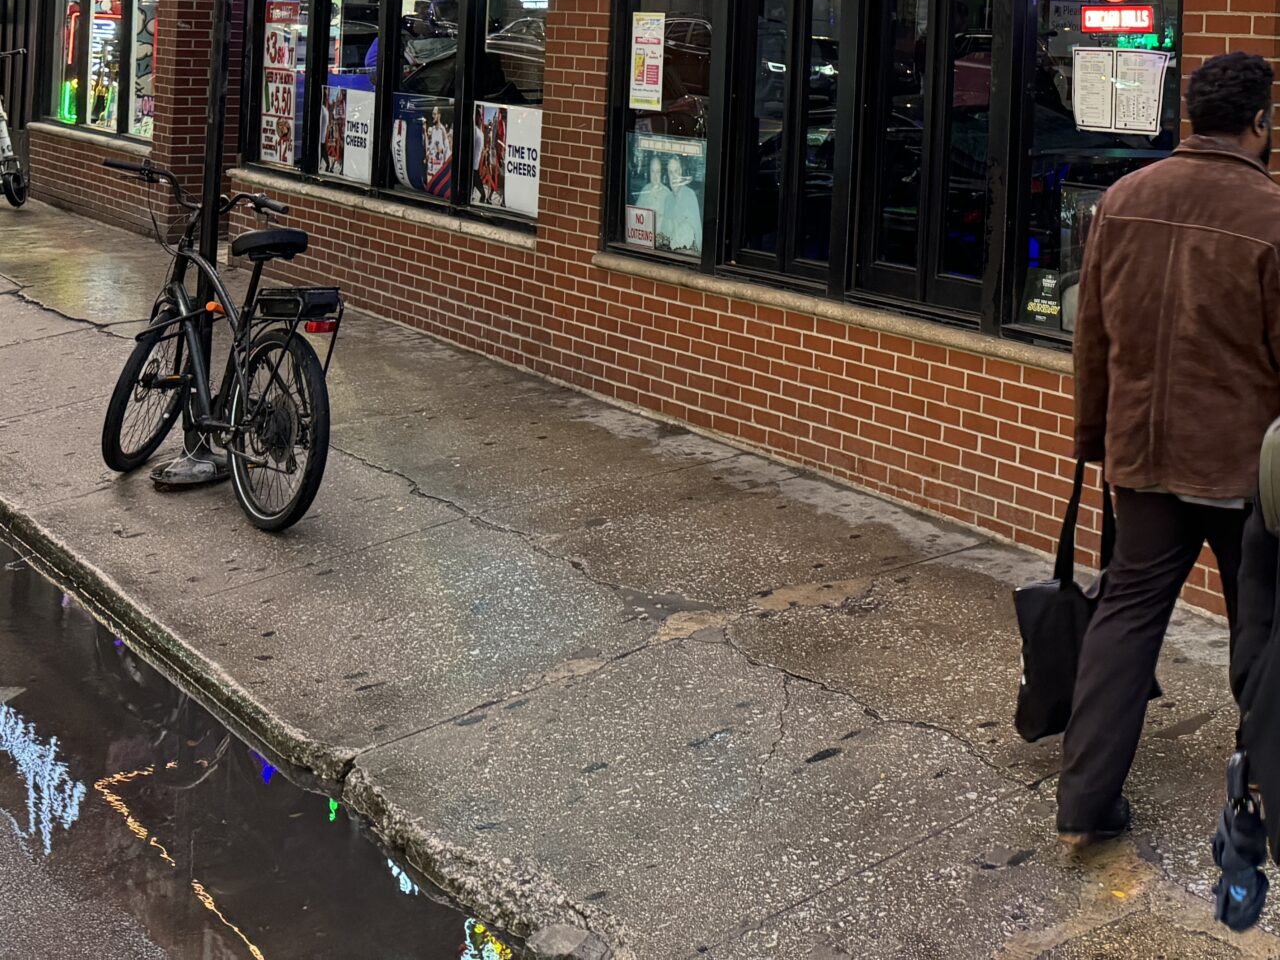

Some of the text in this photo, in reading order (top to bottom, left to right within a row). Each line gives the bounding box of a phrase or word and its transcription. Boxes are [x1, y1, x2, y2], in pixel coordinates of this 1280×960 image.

[347, 120, 368, 134] TIME TO
[346, 135, 367, 149] CHEERS
[507, 144, 538, 161] TIME TO
[507, 161, 537, 178] CHEERS
[636, 213, 645, 225] NO
[628, 228, 653, 242] LOITERING
